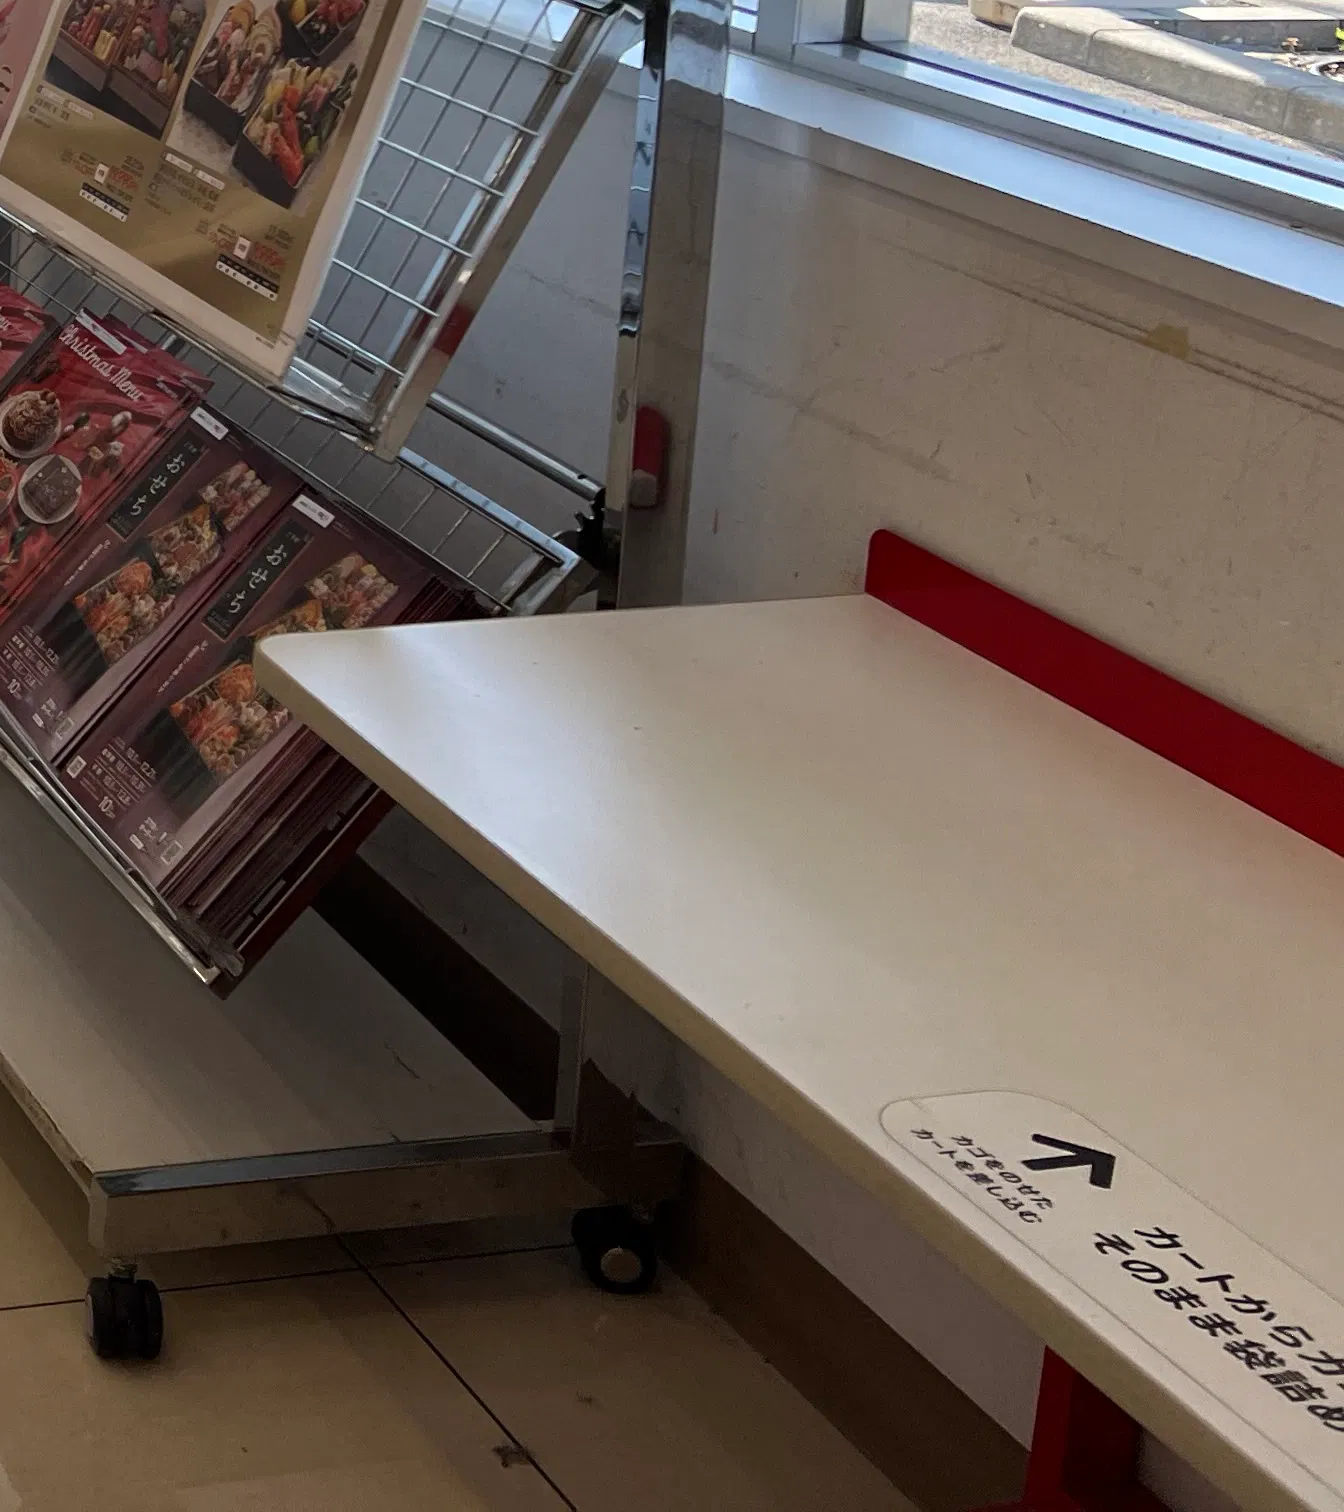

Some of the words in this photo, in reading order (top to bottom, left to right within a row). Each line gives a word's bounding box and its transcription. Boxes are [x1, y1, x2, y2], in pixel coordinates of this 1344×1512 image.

[59, 324, 115, 376] Christmas
[950, 1134, 1053, 1209] カゴをのせた
[1134, 1225, 1344, 1389] カートからカ
